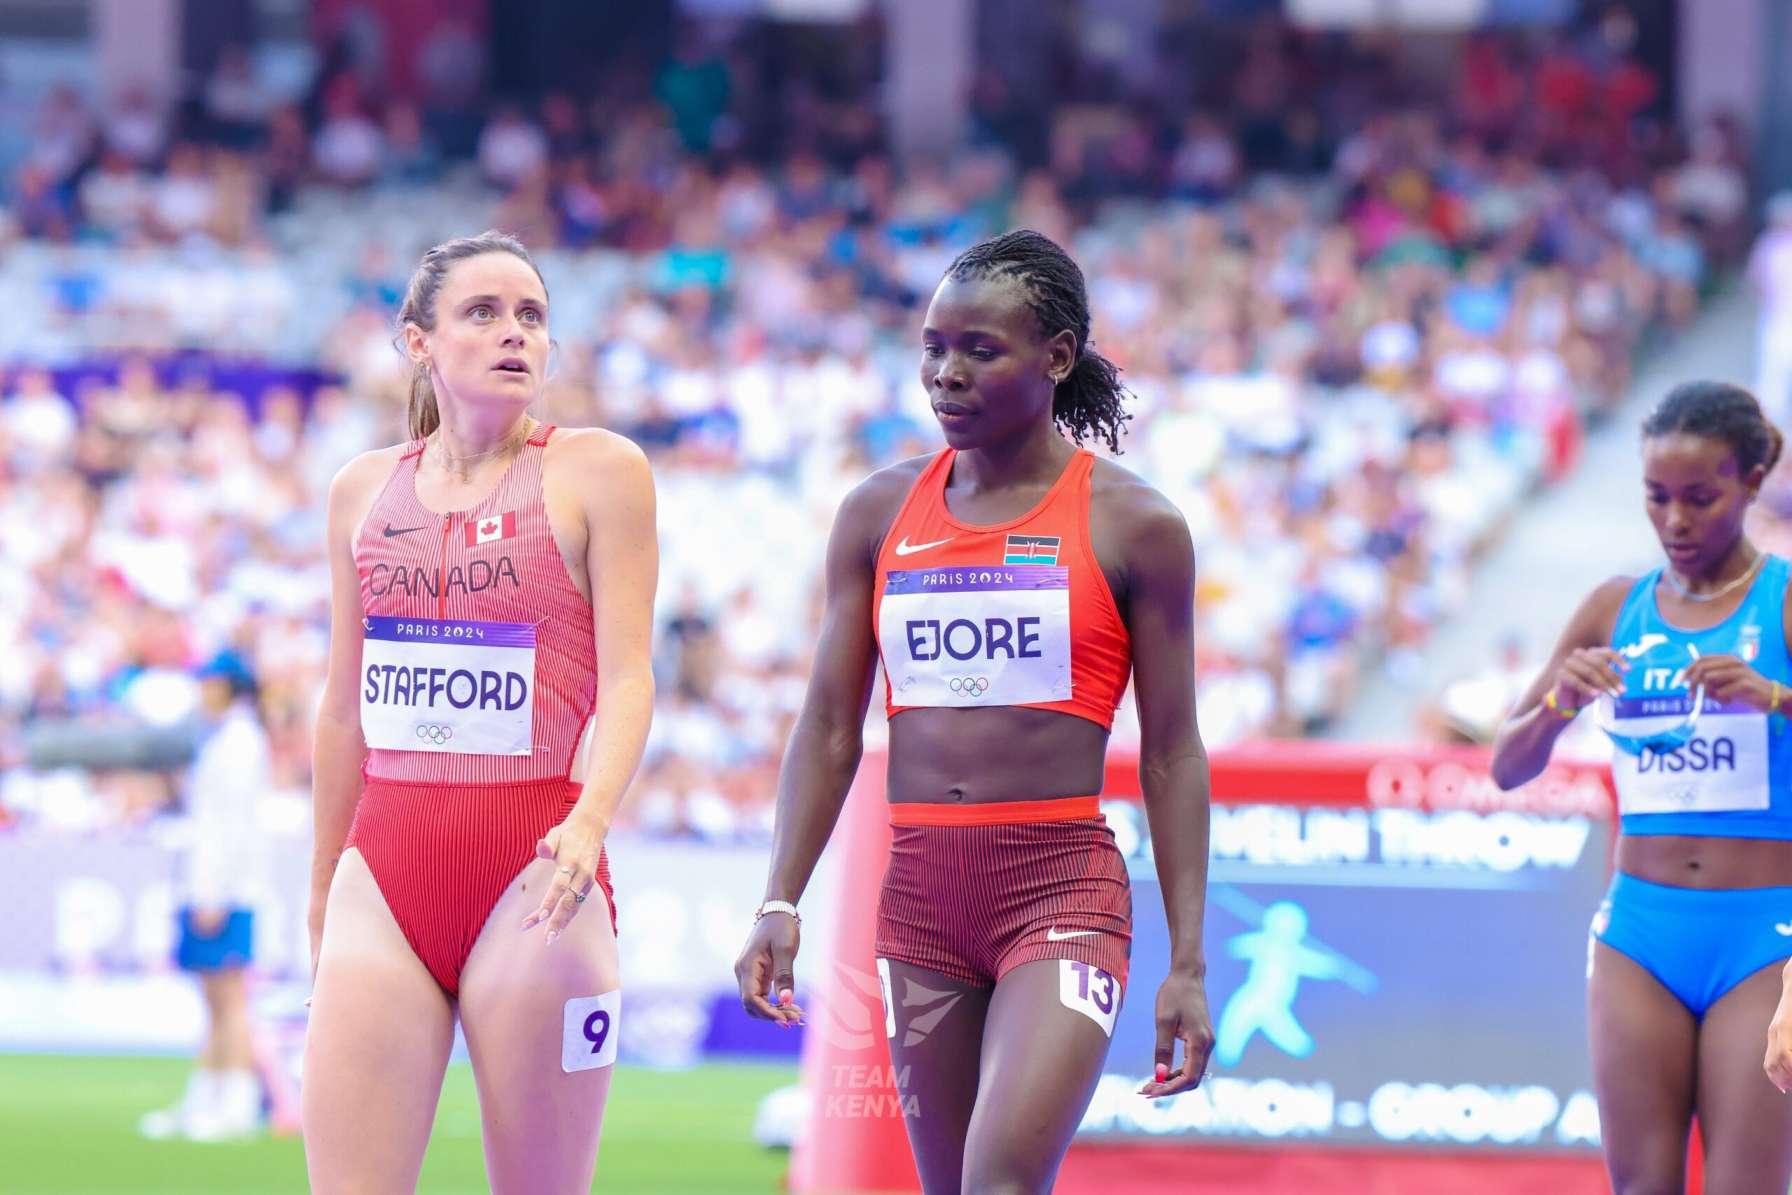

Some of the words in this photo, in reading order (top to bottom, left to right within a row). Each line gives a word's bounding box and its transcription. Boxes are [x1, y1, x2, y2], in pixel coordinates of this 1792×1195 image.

[369, 556, 520, 598] CANADA
[969, 572, 1014, 584] 2024
[397, 623, 439, 637] PARIS
[444, 625, 484, 639] 2024
[906, 616, 1042, 661] EJORE
[365, 663, 528, 711] STAFFORD
[1643, 667, 1691, 690] ITA
[1071, 962, 1114, 1016] 13
[583, 1010, 610, 1054] 9
